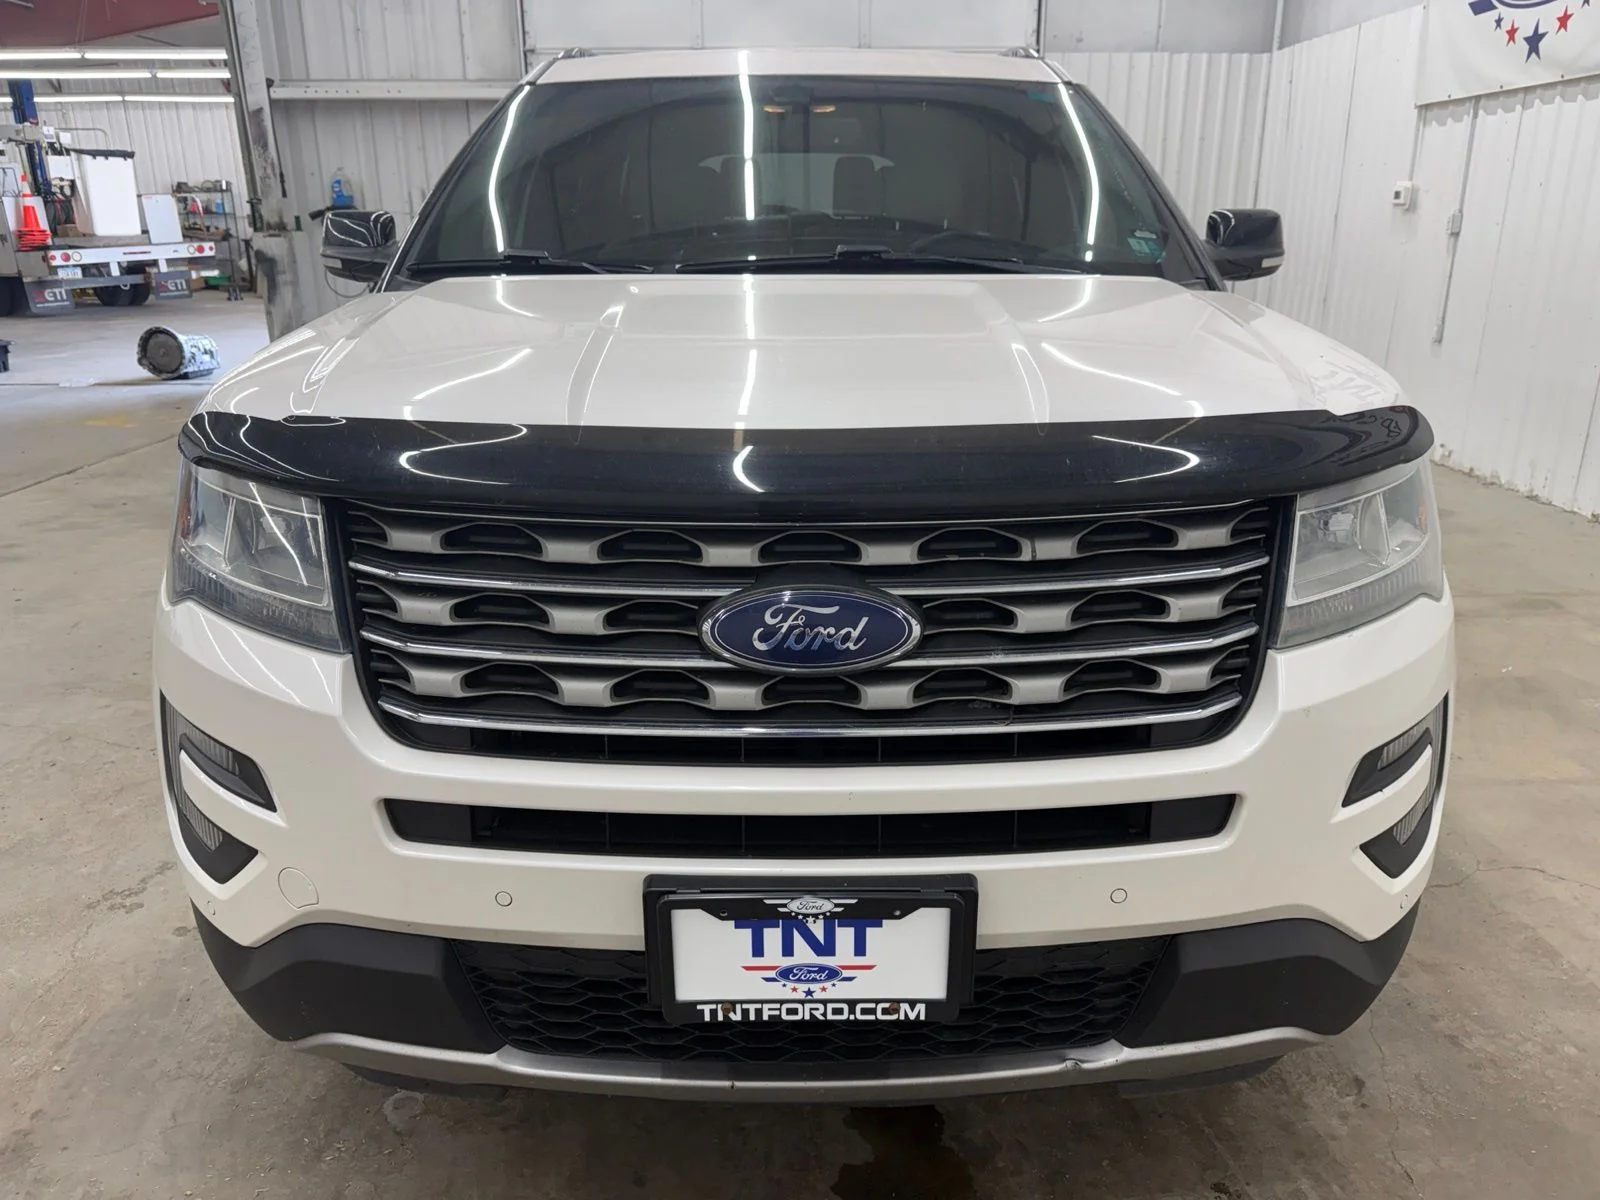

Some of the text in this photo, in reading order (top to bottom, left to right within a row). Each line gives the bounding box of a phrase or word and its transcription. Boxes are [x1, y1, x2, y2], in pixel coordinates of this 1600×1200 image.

[752, 604, 869, 651] Ford
[796, 900, 825, 911] Ford
[734, 919, 883, 958] TNT
[789, 966, 828, 981] Ford
[697, 1002, 926, 1022] TNTFORD.COM
